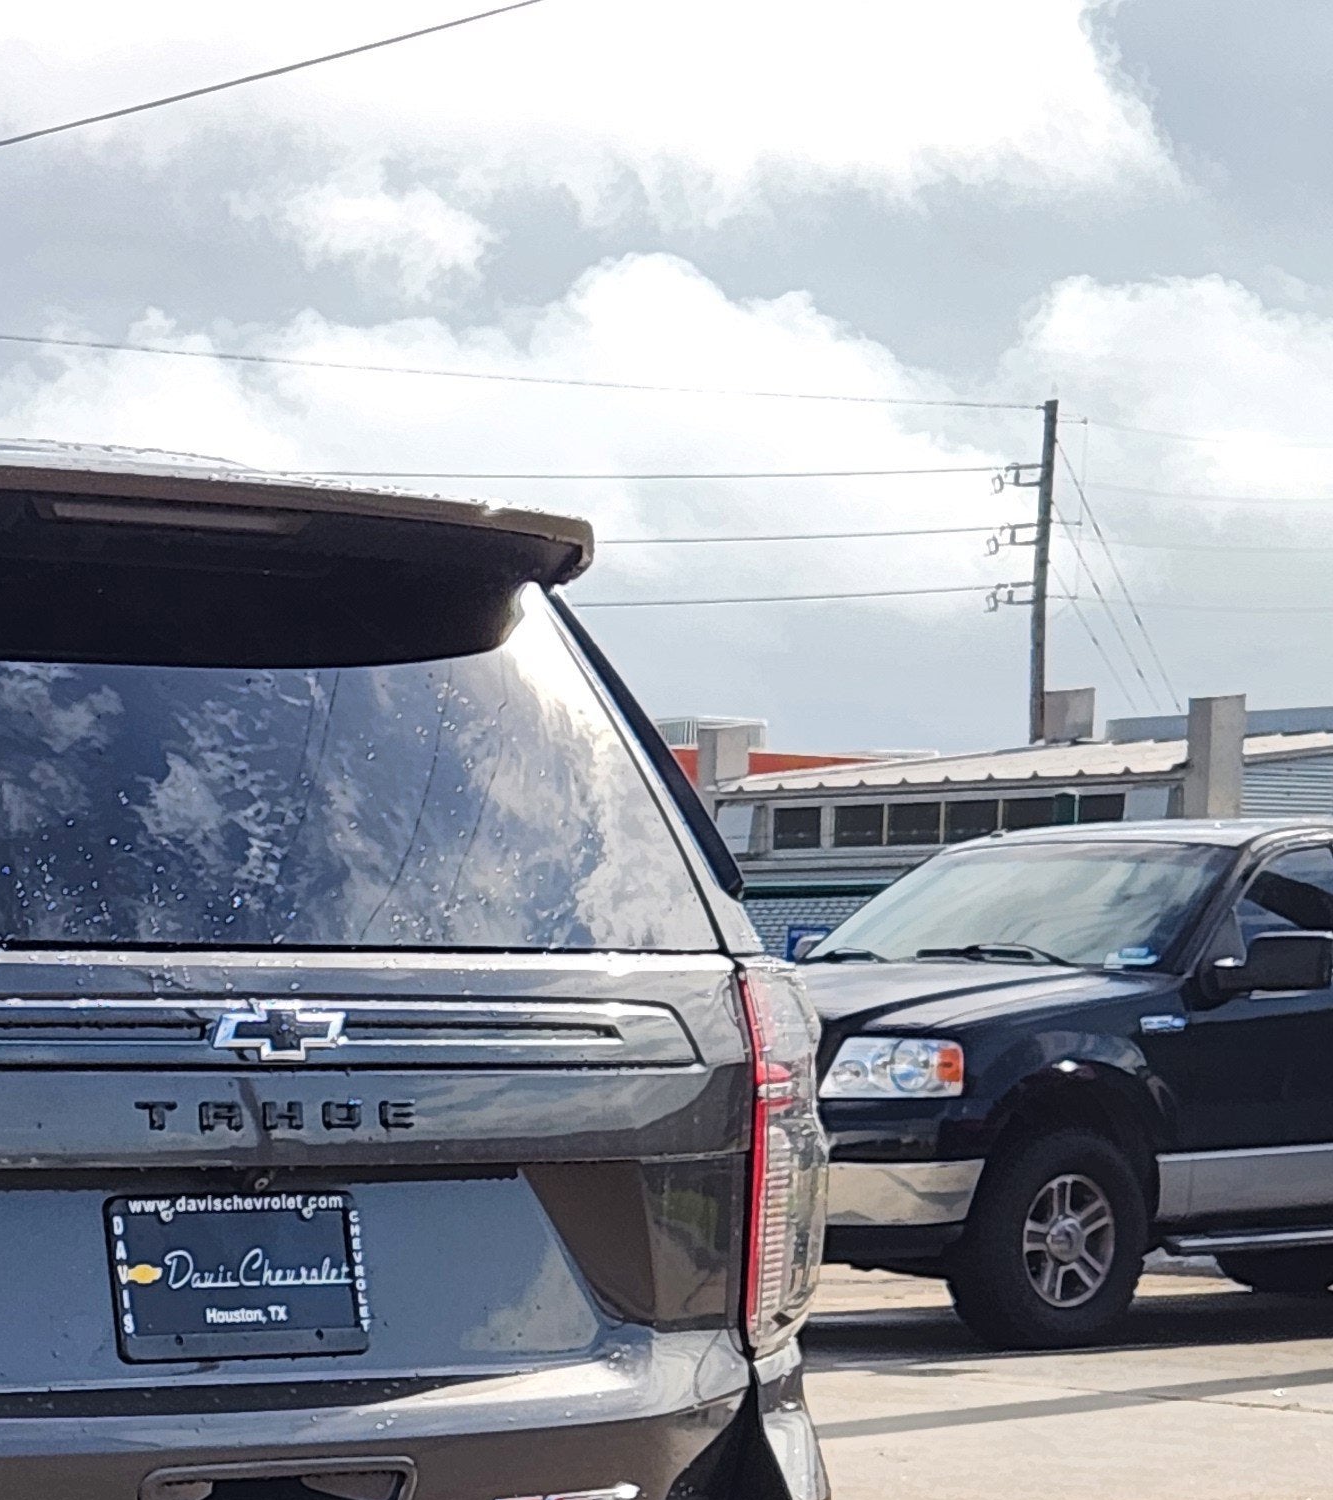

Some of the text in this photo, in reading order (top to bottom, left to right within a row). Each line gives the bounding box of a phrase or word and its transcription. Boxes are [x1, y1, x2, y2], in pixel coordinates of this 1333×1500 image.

[134, 1099, 416, 1131] TAHOE
[128, 1194, 344, 1214] www.davischevrolet.com
[112, 1215, 135, 1335] DAVIS
[163, 1248, 353, 1290] Davis Chevrolet
[348, 1210, 371, 1333] CHEVROLET
[205, 1305, 289, 1325] Houston, TX
